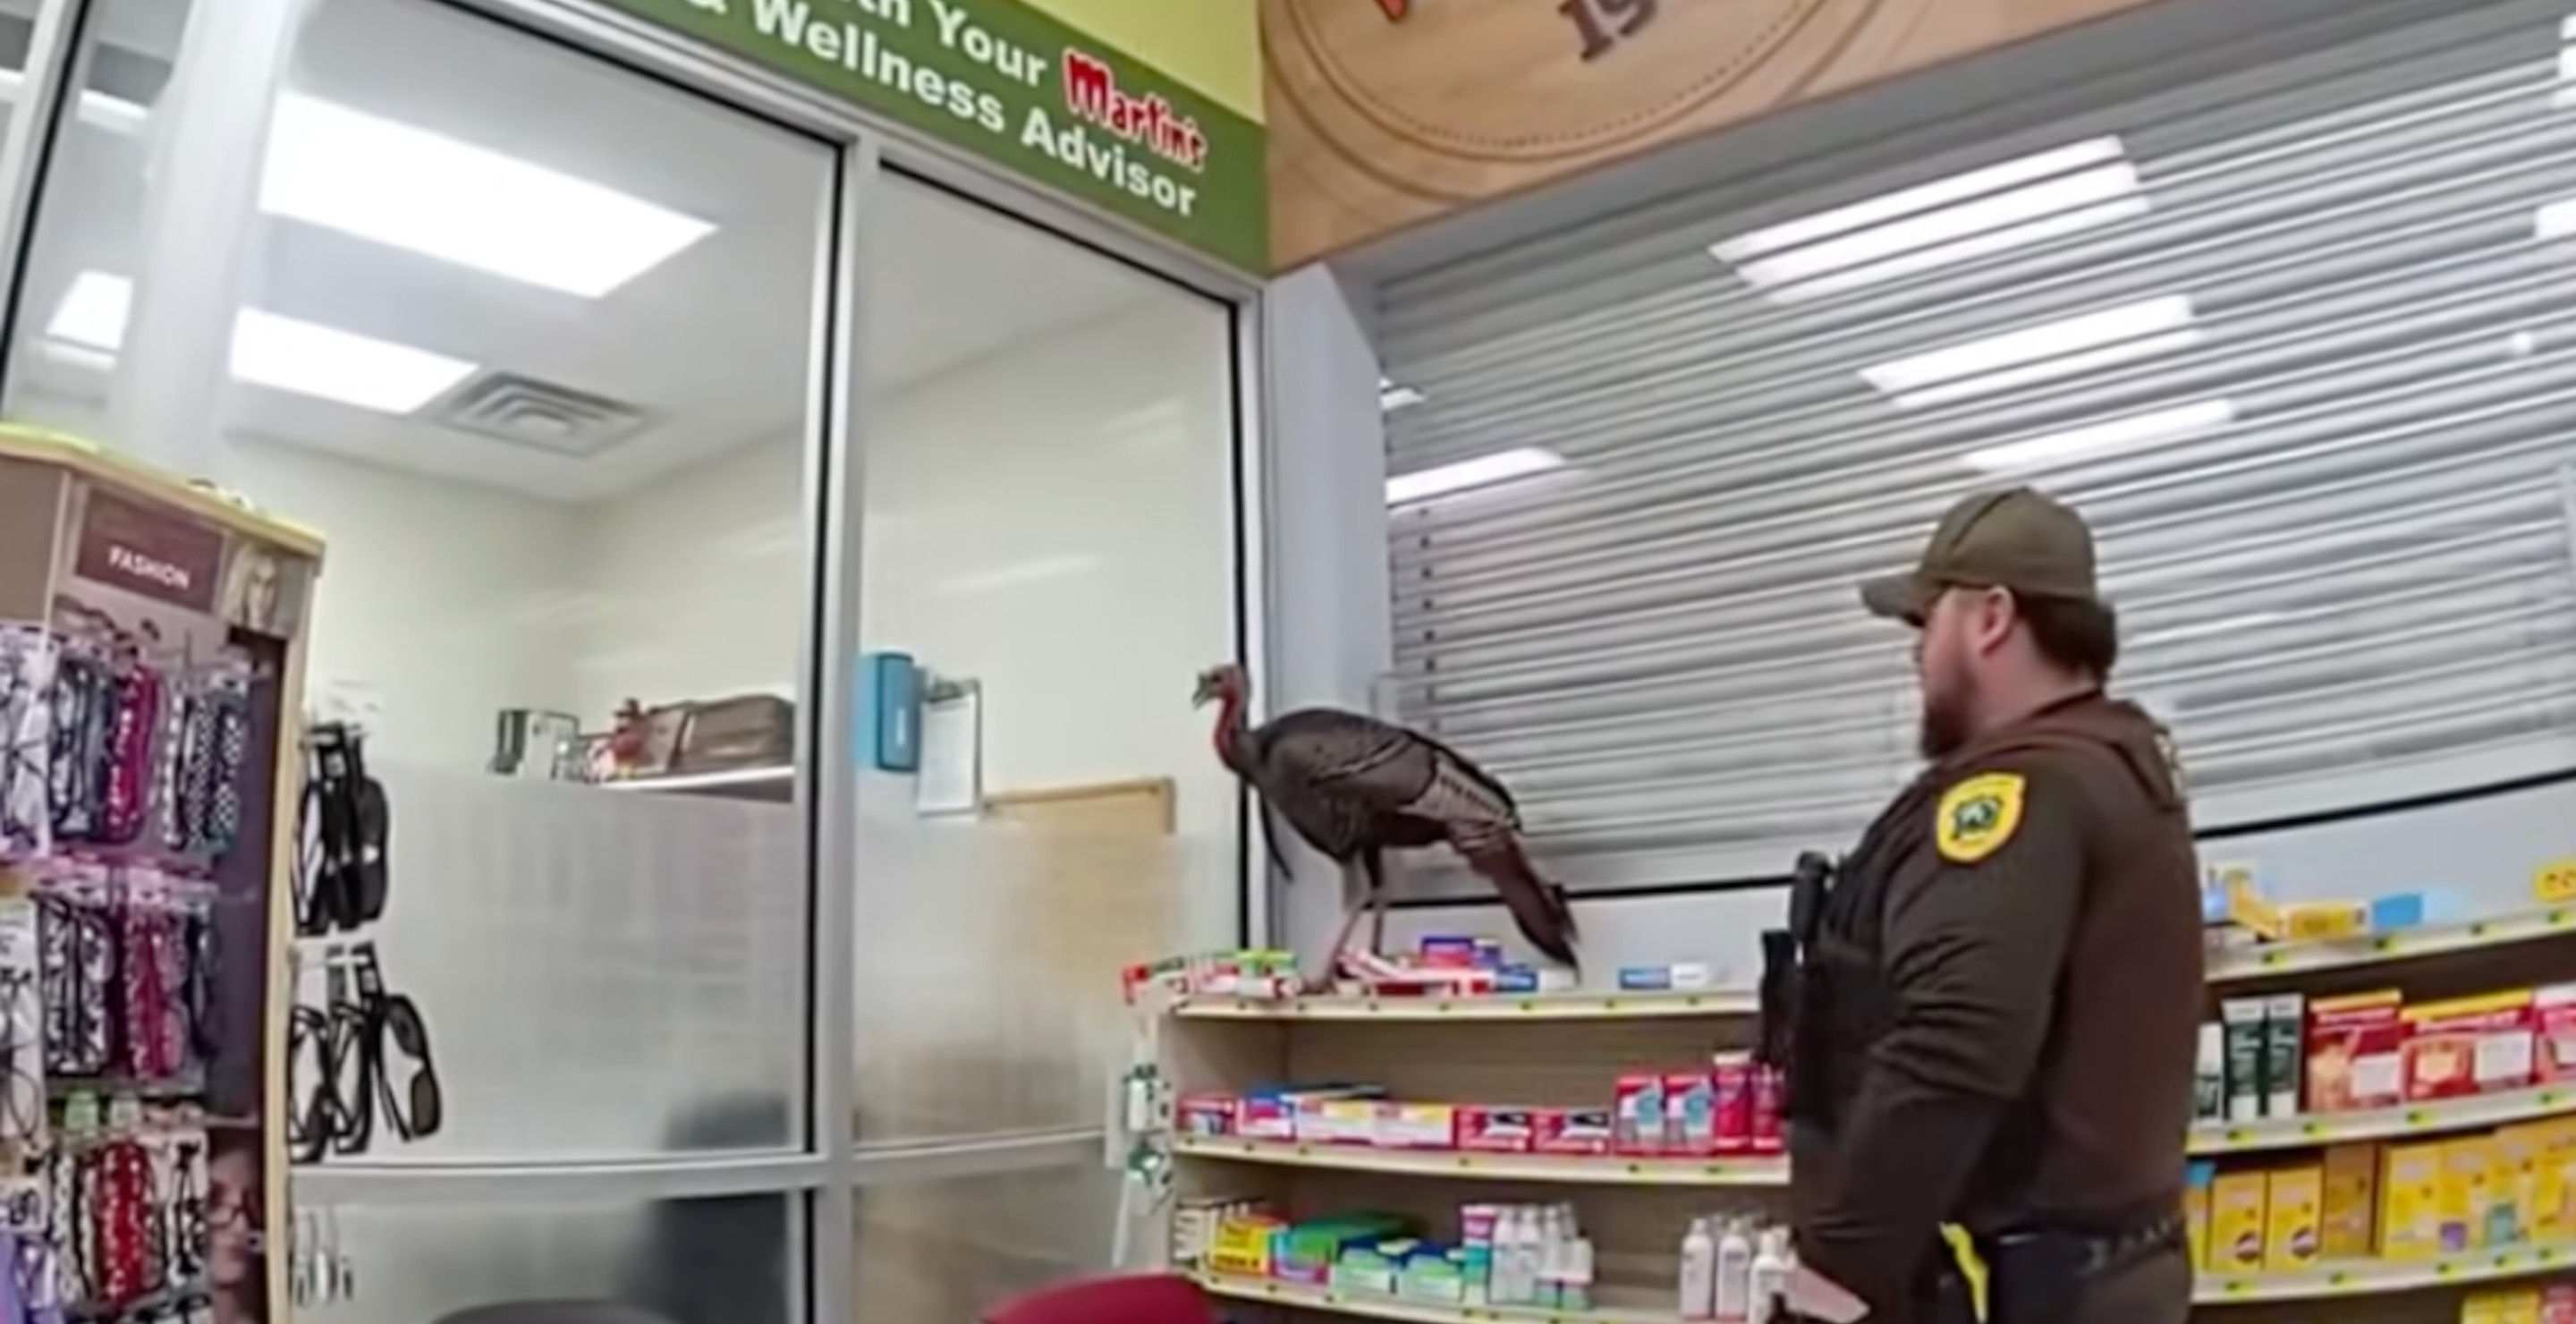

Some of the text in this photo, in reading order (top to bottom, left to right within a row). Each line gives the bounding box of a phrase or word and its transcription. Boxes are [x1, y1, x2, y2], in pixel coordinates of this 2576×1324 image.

[928, 0, 1048, 87] Your
[752, 0, 1197, 216] Wellness Advisor
[108, 544, 191, 590] FASHION
